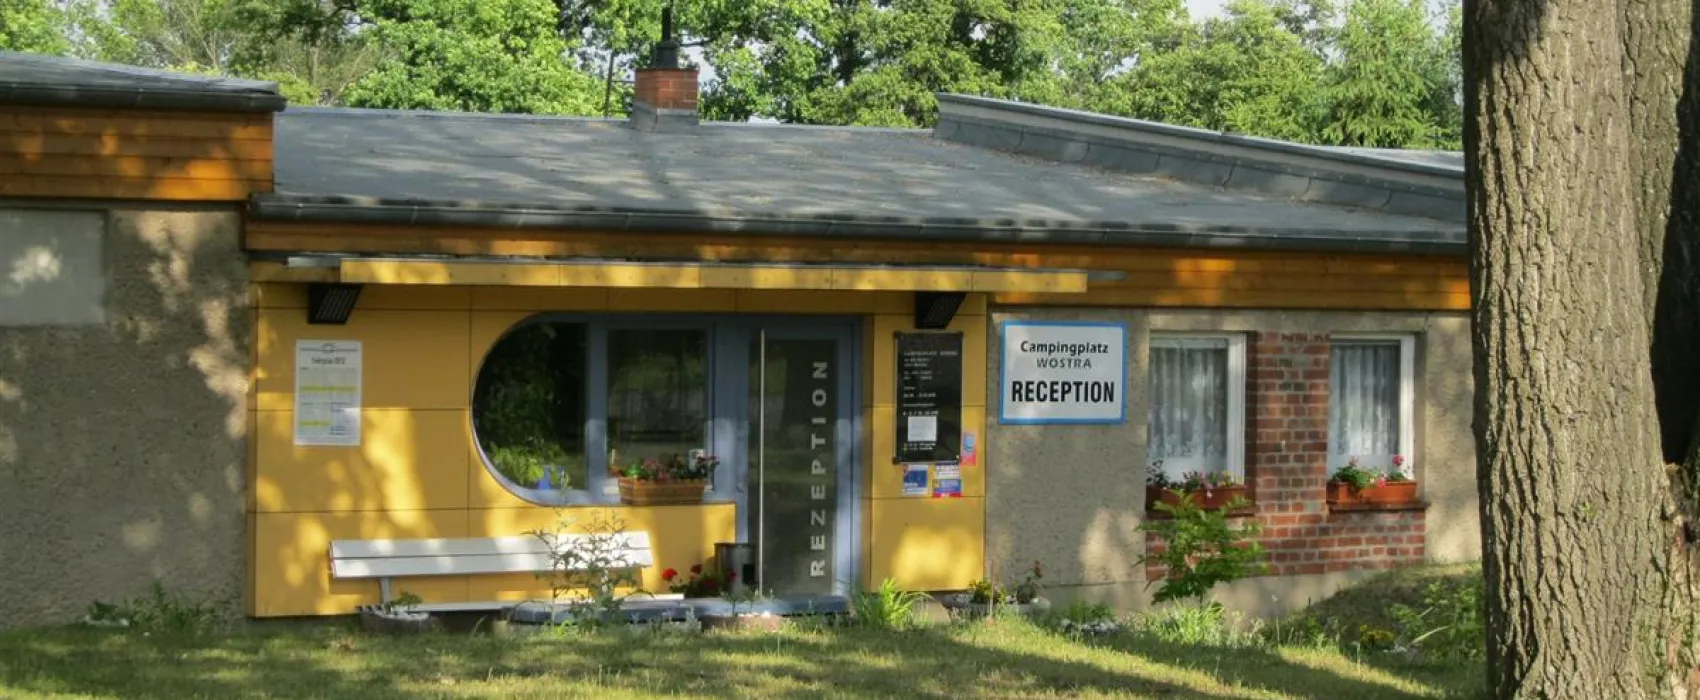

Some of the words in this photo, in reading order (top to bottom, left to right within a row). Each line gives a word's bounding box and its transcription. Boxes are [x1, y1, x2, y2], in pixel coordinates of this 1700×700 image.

[1020, 340, 1109, 356] Campingplatz
[1036, 357, 1092, 369] WOSTRA
[1011, 380, 1115, 403] RECEPTION
[810, 361, 829, 577] REZEPTION
